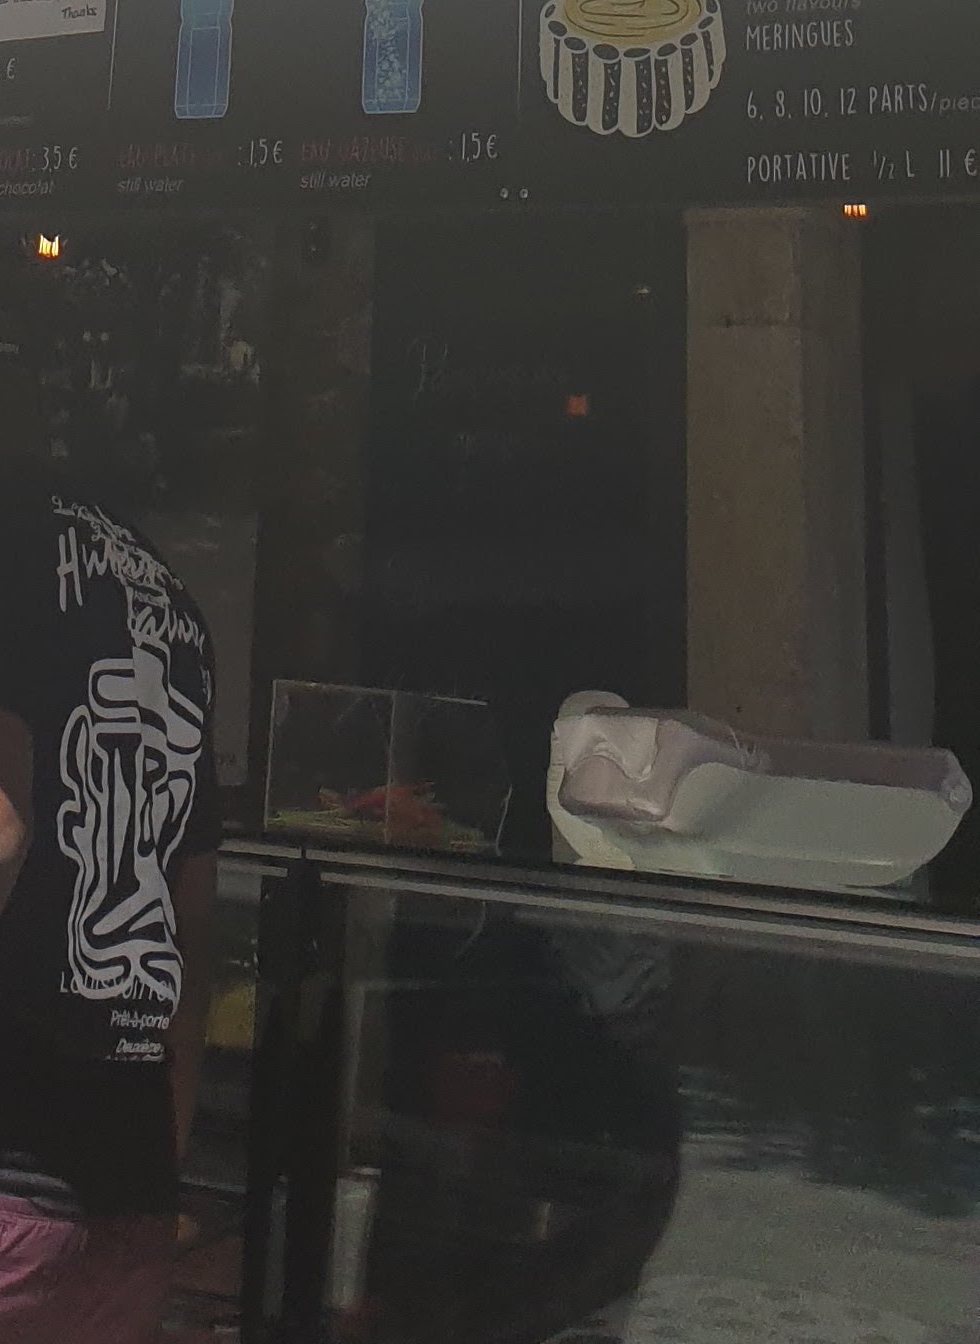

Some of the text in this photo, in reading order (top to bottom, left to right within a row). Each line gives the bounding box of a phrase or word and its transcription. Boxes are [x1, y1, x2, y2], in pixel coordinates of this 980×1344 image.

[62, 4, 98, 18] Thanks
[747, 0, 777, 14] two
[746, 19, 854, 51] MERINGUES
[747, 152, 850, 183] PORTATIVE
[144, 177, 184, 192] water
[300, 171, 371, 189] still water
